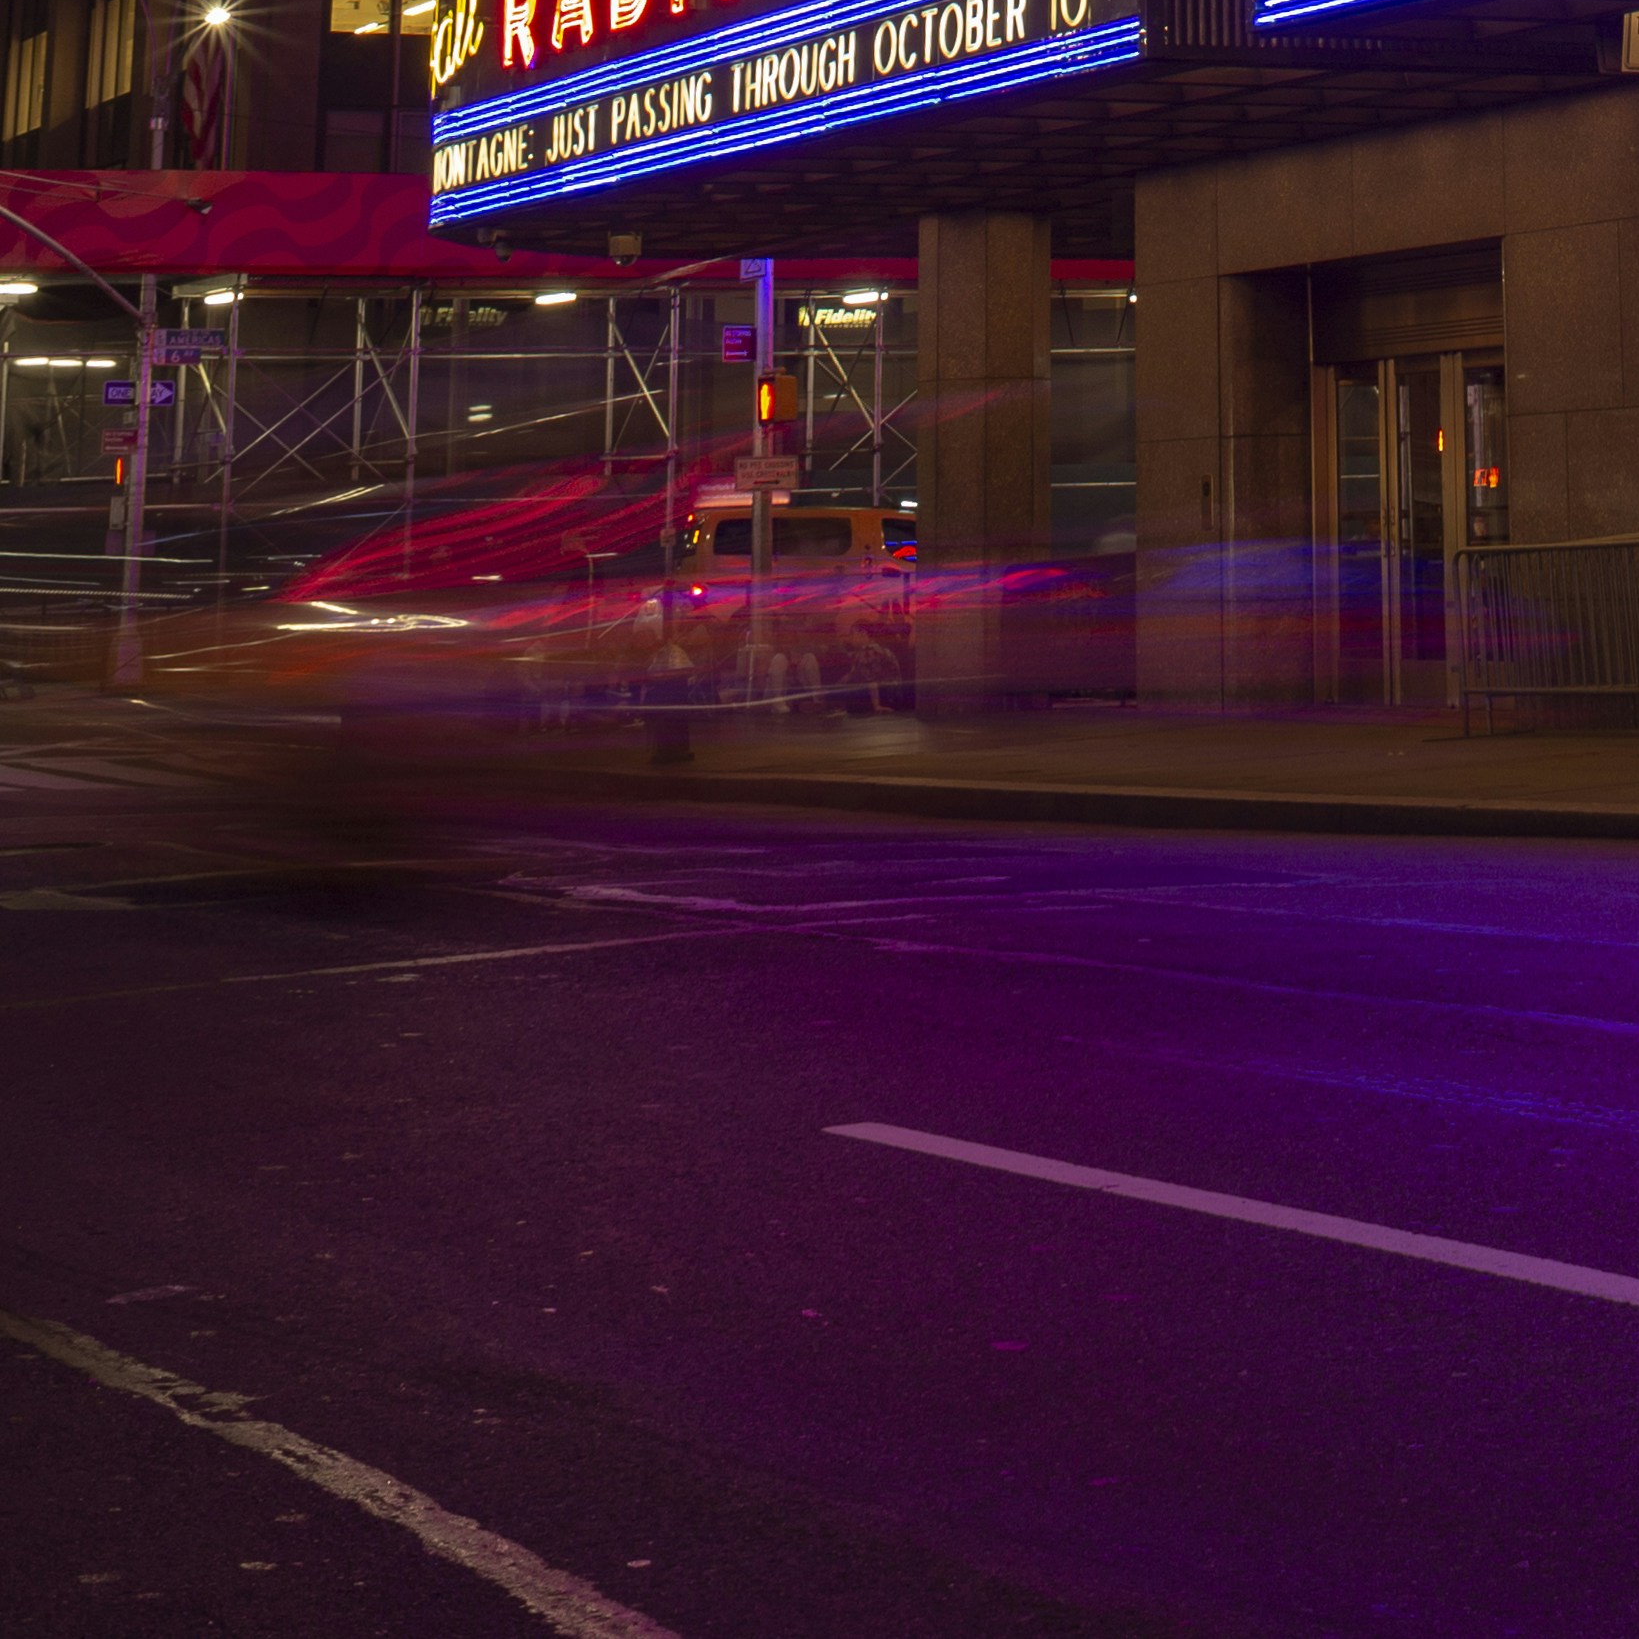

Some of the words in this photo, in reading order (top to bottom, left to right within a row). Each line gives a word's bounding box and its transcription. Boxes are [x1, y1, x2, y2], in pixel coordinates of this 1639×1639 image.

[546, 103, 599, 162] JUST
[610, 71, 713, 145] PASSING
[730, 30, 856, 114] THROUGH
